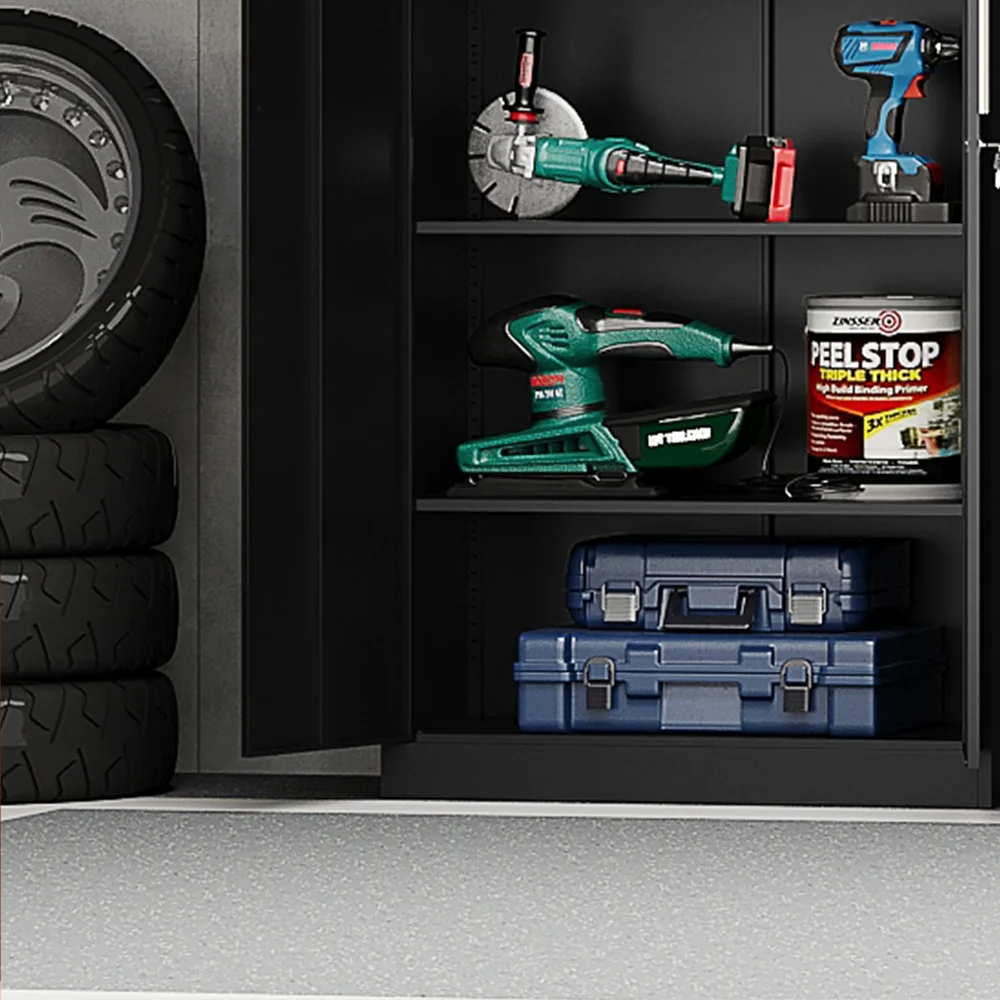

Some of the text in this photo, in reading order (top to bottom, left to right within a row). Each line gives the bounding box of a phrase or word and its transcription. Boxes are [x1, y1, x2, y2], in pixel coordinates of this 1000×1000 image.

[832, 316, 881, 327] ZINSSER
[811, 340, 940, 369] PEEL STOP
[819, 367, 922, 382] TRIPLE THICK
[831, 384, 854, 394] Build
[855, 385, 893, 396] Binding
[895, 384, 928, 394] Primer
